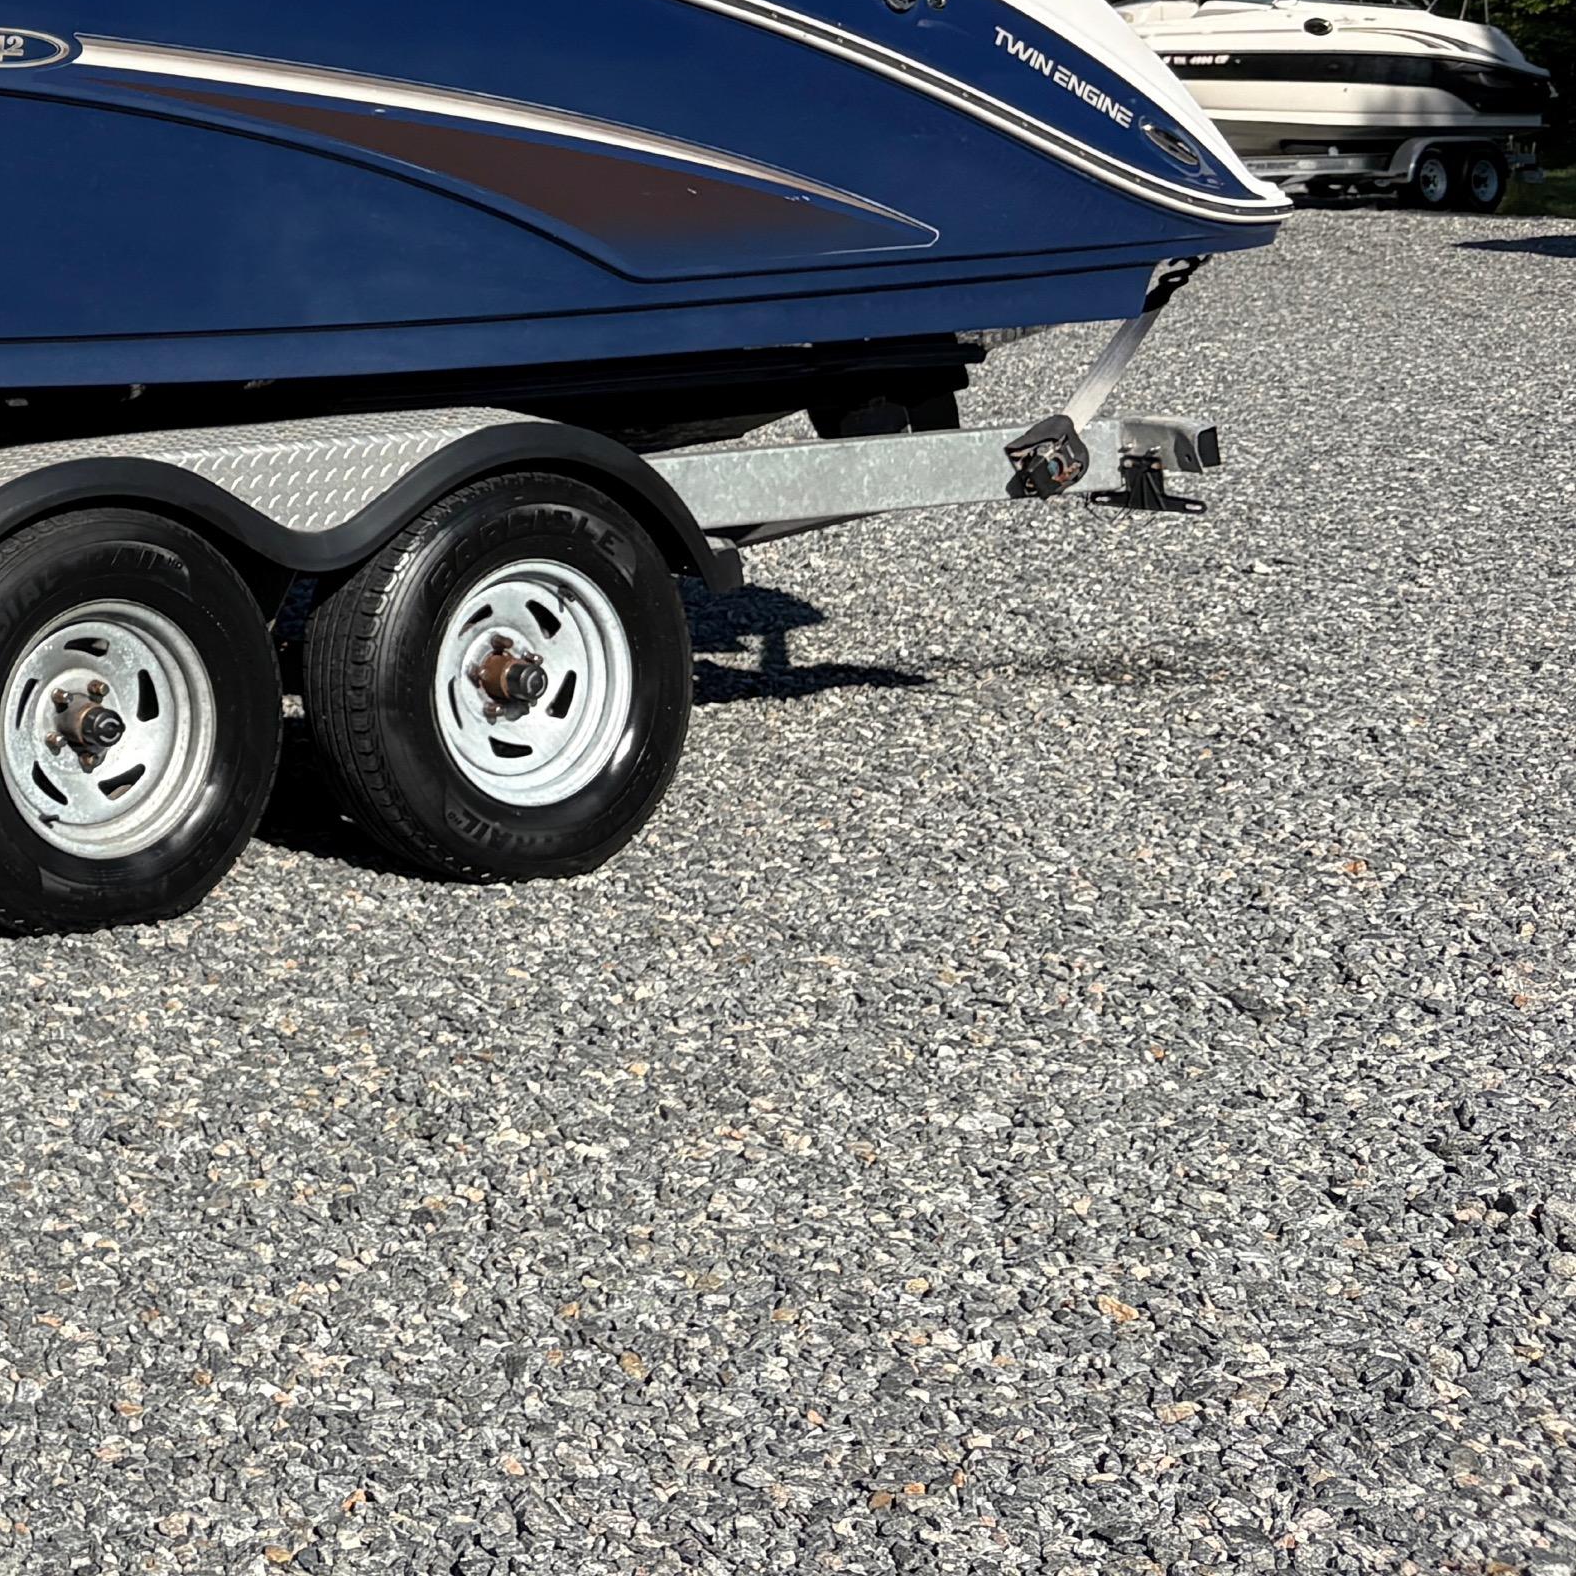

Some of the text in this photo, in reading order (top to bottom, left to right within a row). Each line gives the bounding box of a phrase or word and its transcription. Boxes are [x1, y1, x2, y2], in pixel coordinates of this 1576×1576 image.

[994, 25, 1134, 129] TWIN ENGINE
[429, 508, 625, 593] CARLISLE
